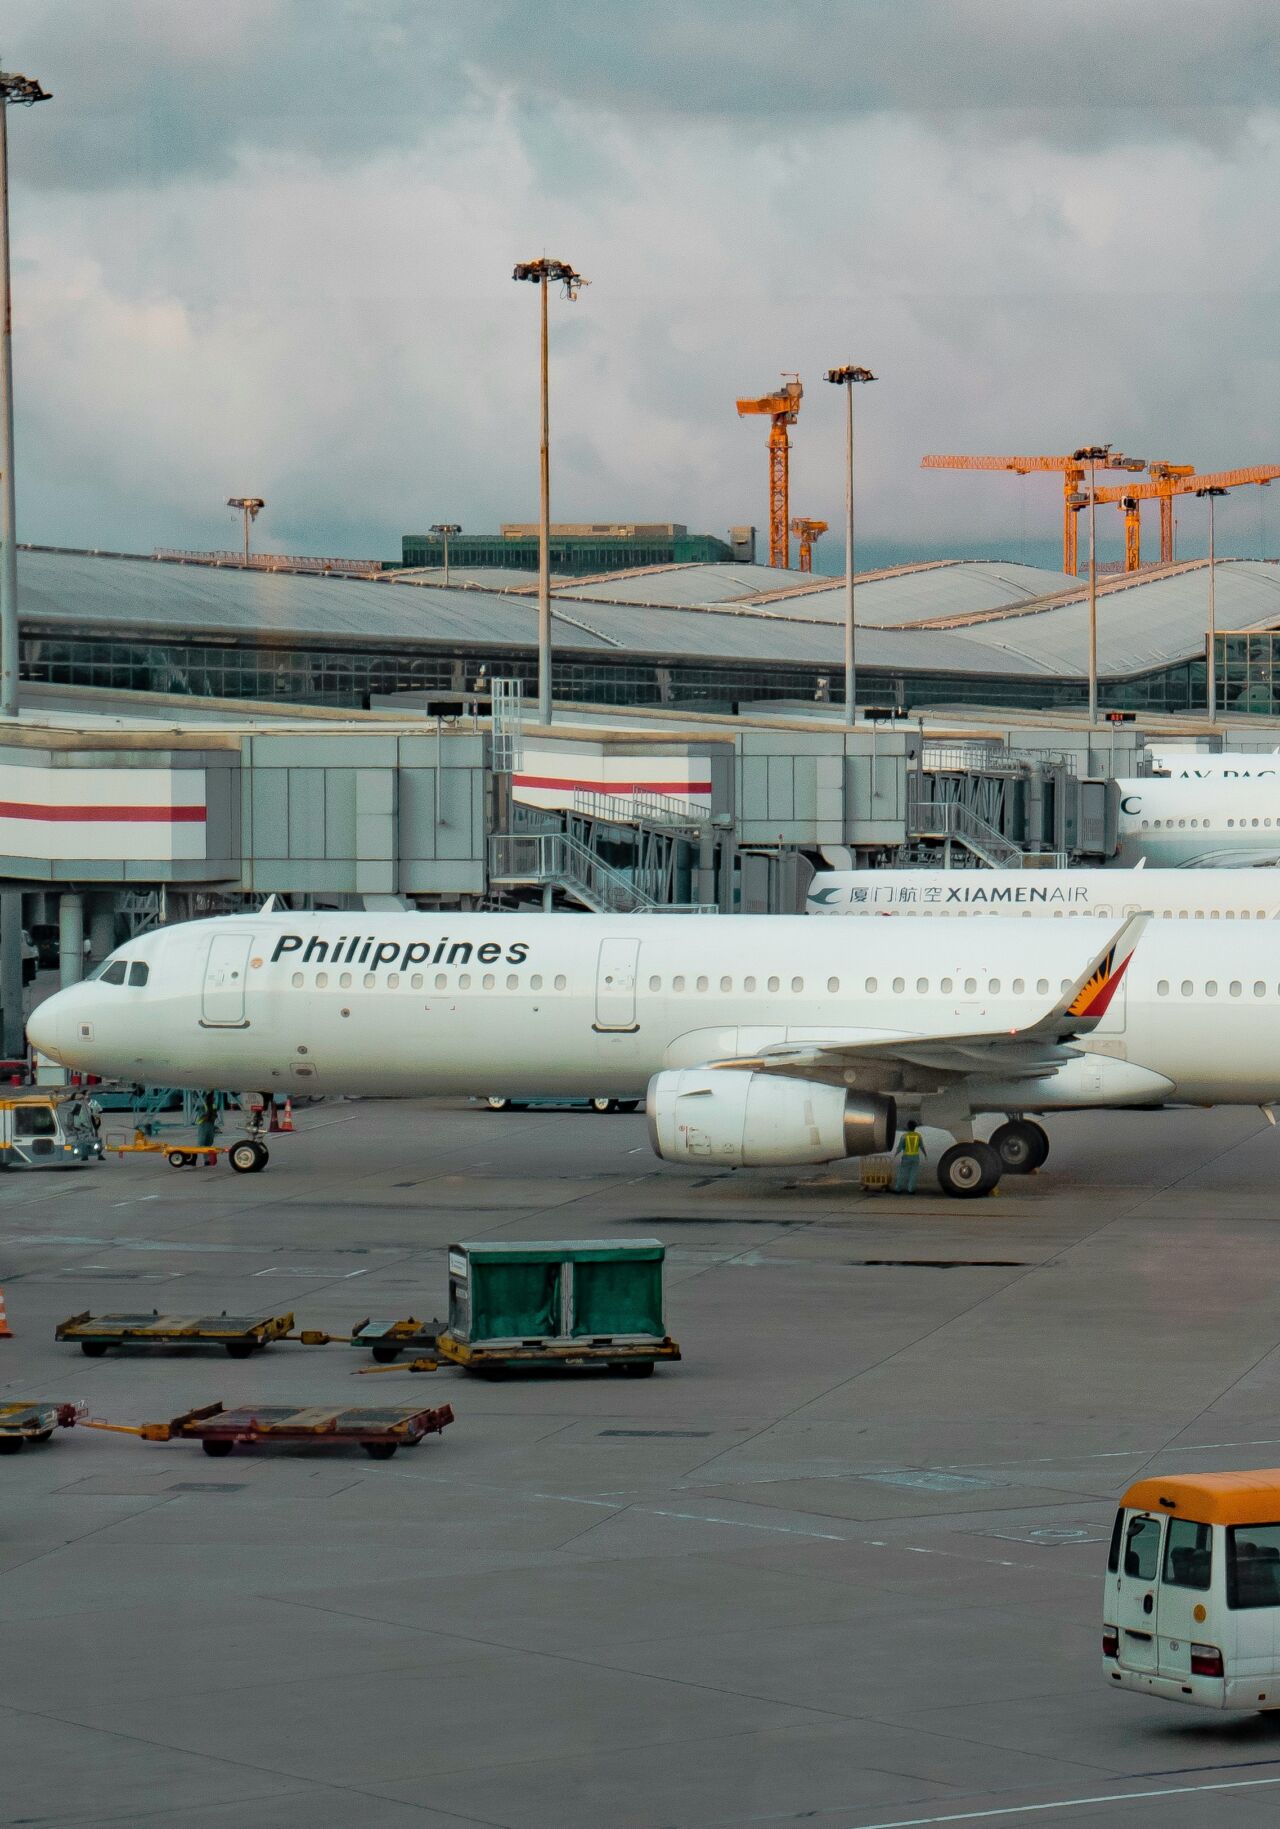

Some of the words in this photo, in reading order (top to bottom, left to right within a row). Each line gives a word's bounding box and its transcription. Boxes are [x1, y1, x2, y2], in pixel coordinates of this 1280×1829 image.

[850, 887, 942, 903] 厦门航空
[270, 935, 529, 971] Philippines
